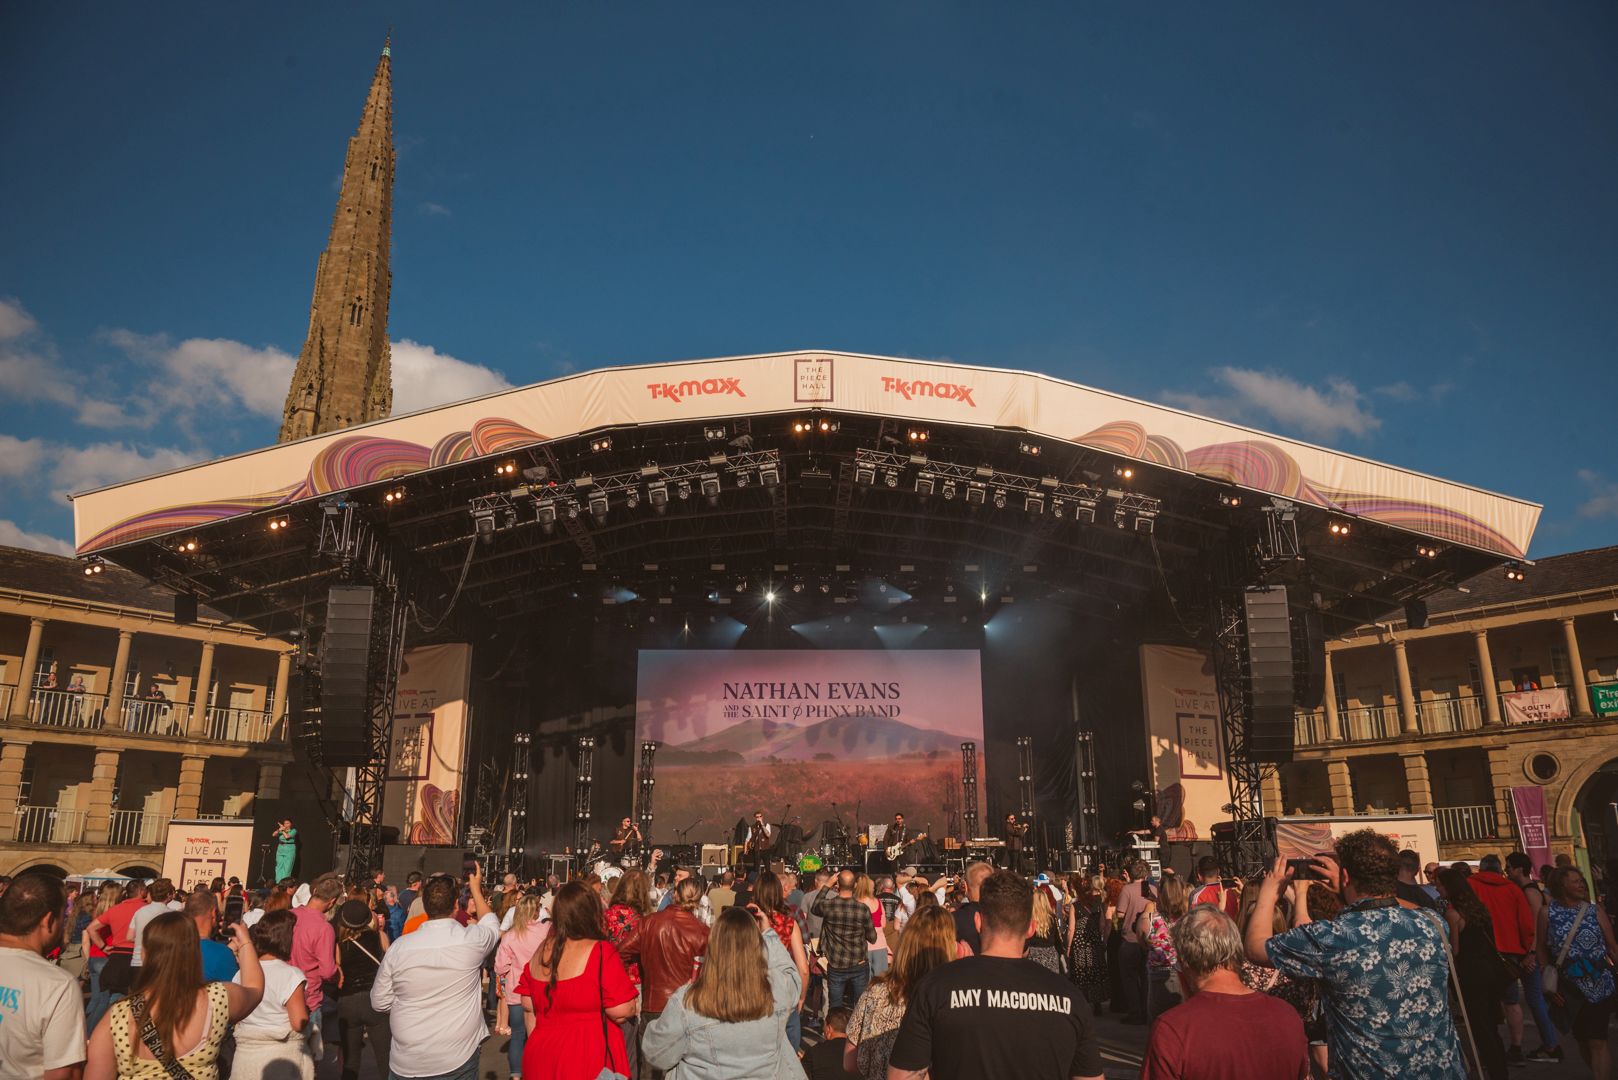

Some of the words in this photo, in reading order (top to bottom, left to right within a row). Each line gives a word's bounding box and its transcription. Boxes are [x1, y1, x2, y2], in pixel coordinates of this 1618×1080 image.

[723, 682, 820, 700] NATHAN
[828, 682, 900, 700] EVANS
[421, 698, 437, 709] AT
[1175, 698, 1199, 710] LIVE
[1203, 700, 1216, 710] AT
[1600, 699, 1618, 709] exi
[742, 704, 789, 718] SAINT
[806, 704, 850, 718] PHNX
[855, 704, 900, 718] BAND
[402, 726, 421, 734] THE
[1188, 726, 1208, 734] THE
[1184, 738, 1213, 747] PIECE
[1187, 751, 1213, 760] HALL
[1405, 840, 1418, 849] AT
[184, 846, 209, 855] LIVE
[213, 846, 228, 855] AT
[950, 989, 981, 1009] AMY
[987, 989, 1072, 1015] MACDONALD
